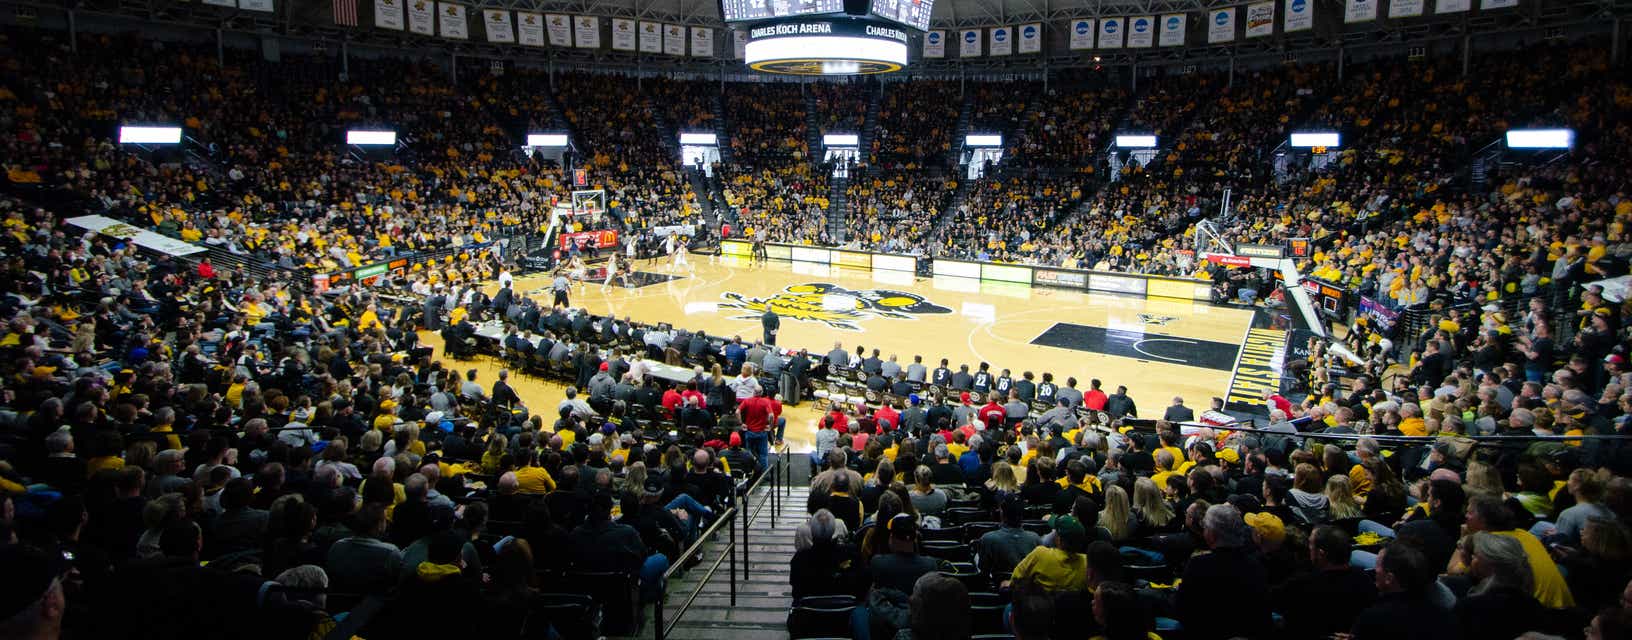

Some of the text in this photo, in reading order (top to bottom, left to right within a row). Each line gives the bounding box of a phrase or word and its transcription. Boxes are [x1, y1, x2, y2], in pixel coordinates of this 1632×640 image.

[752, 23, 832, 38] CHARLES KOCH ARENA
[866, 25, 895, 38] CHARLES
[1239, 327, 1288, 368] WICHITA
[976, 376, 986, 387] 22
[999, 381, 1008, 391] 10
[1227, 367, 1281, 406] STATE
[1040, 386, 1052, 396] 20
